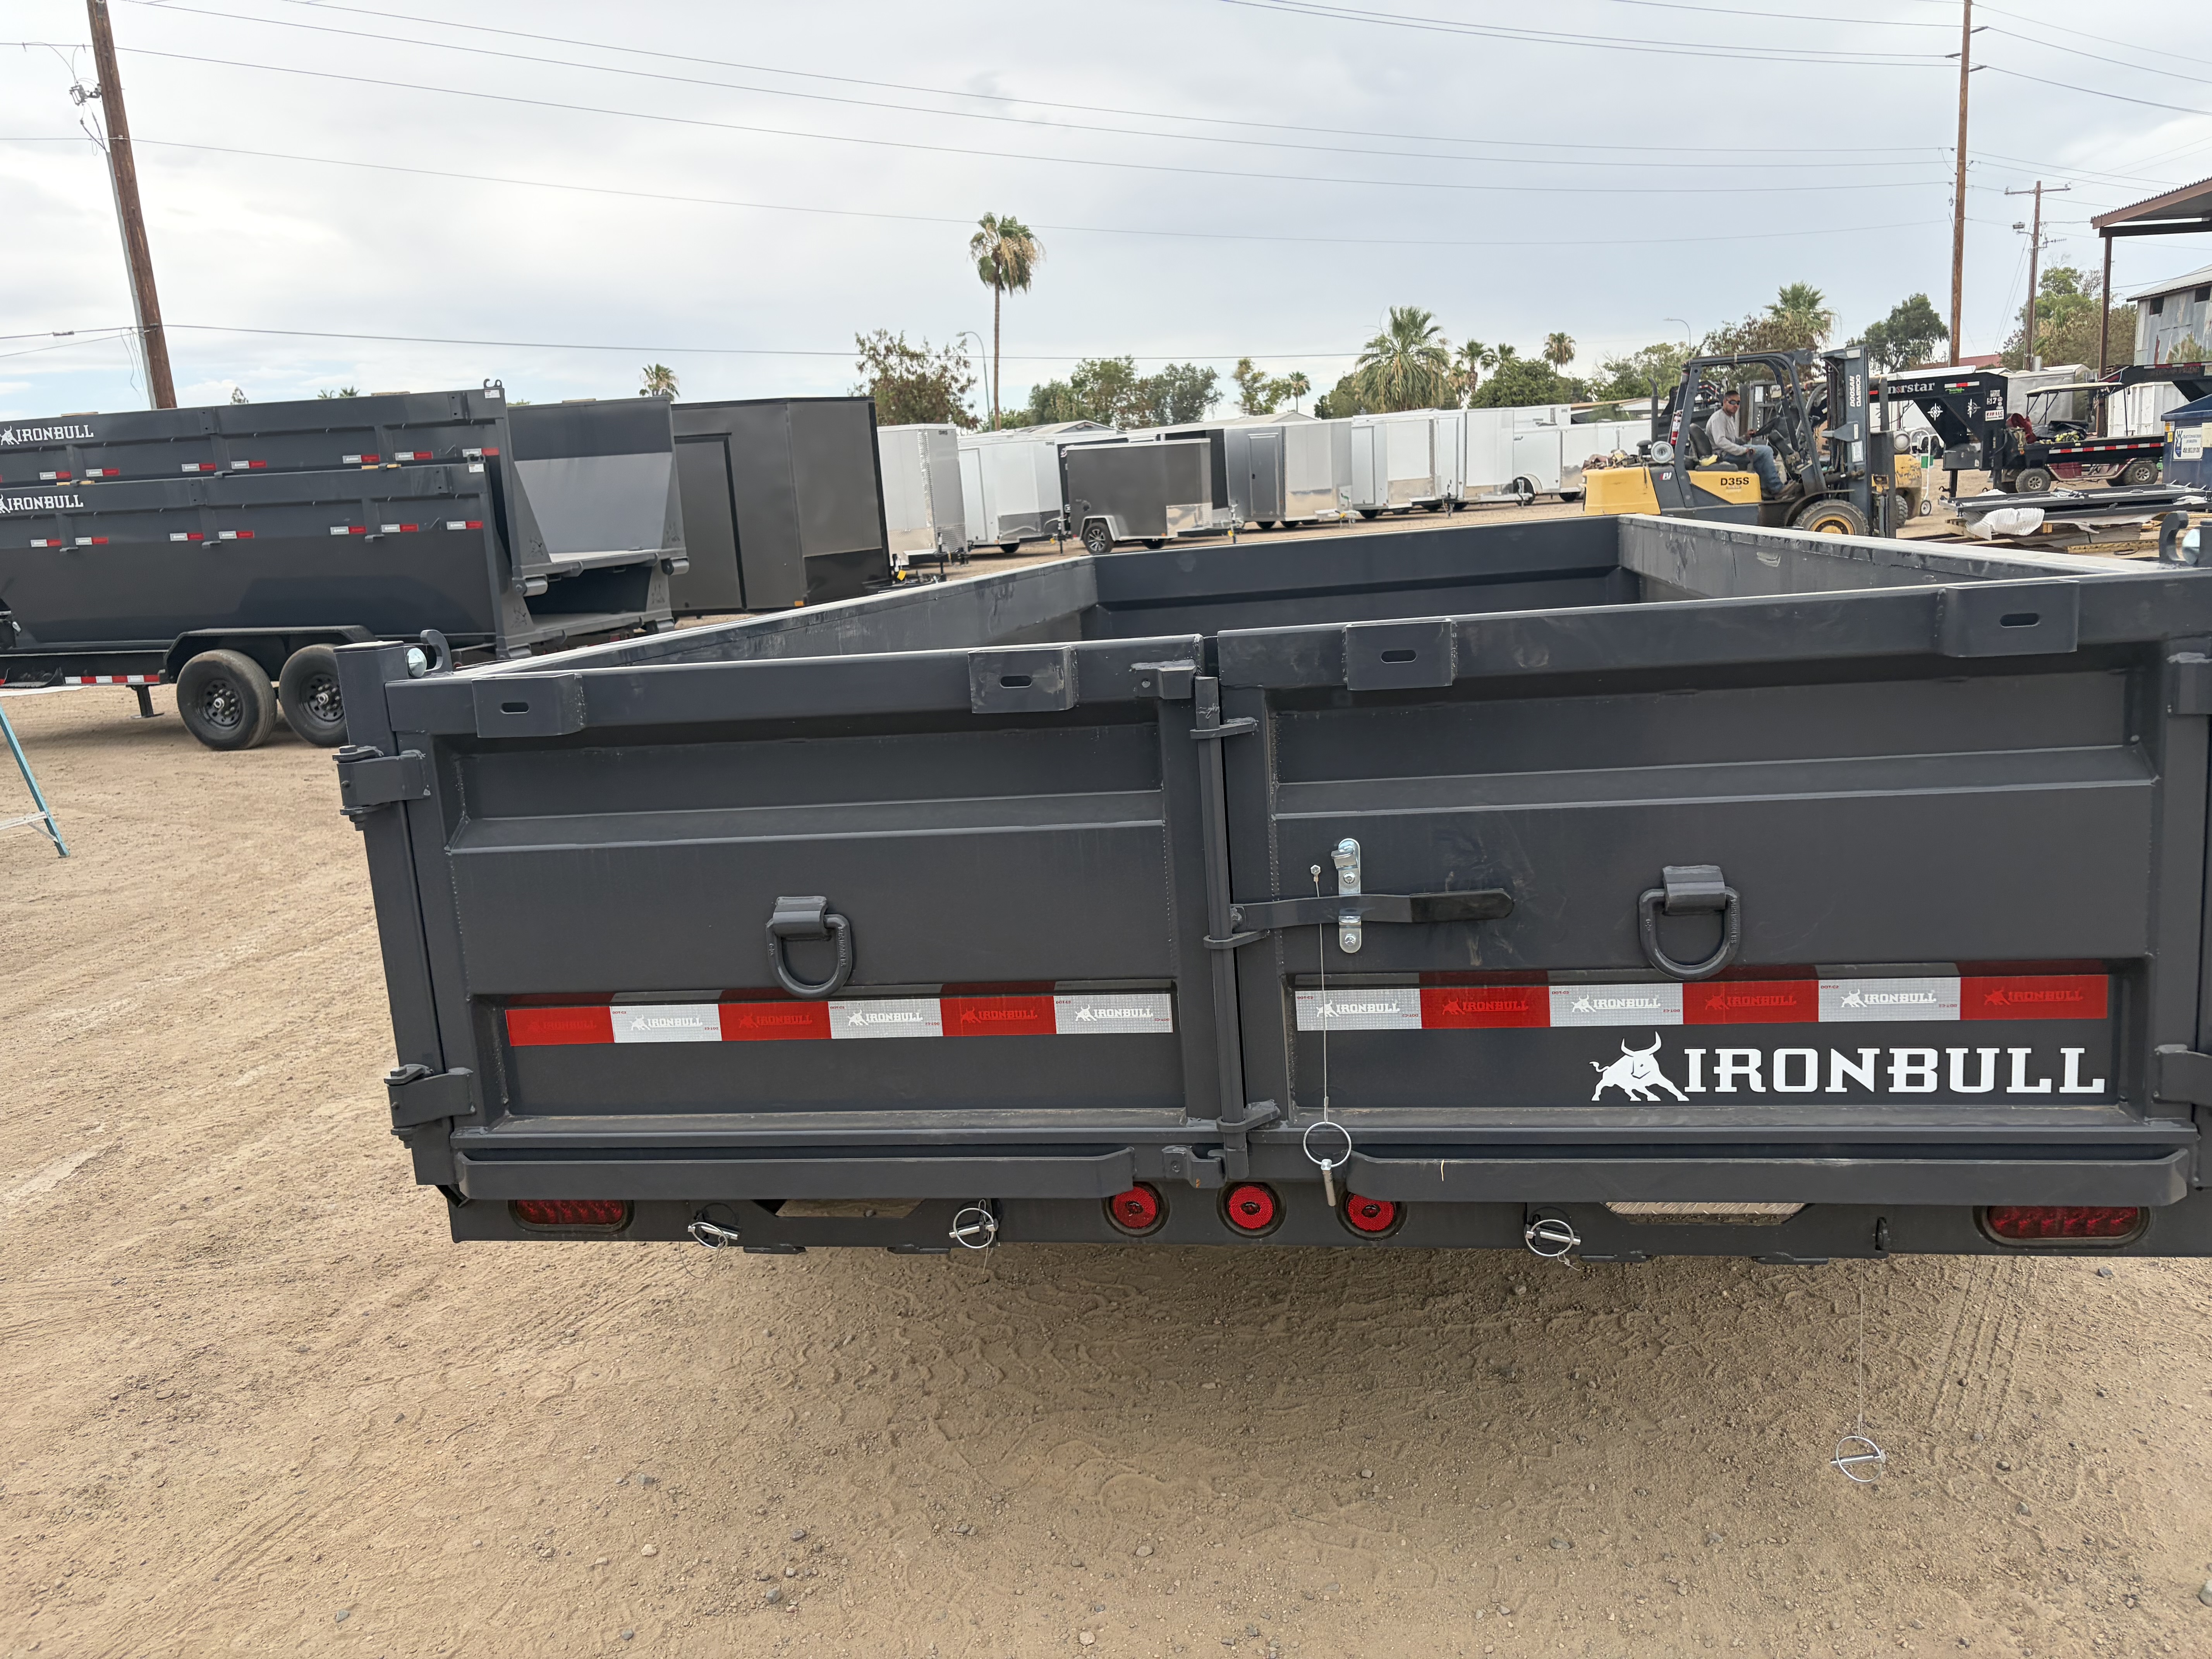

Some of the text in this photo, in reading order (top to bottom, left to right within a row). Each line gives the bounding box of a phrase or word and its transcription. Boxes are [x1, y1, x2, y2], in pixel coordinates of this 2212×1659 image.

[16, 424, 94, 442] IRONBULL
[1721, 477, 1749, 486] D35S
[7, 495, 84, 511] IRONBULL
[1727, 996, 1796, 1006] IRONBULL
[1864, 993, 1936, 1003] IRONBULL
[2008, 991, 2083, 1002] IRONBULL
[1336, 1003, 1400, 1013] IRONBULL
[1463, 1001, 1528, 1011] IRONBULL
[1593, 998, 1661, 1008] IRONBULL
[866, 1012, 923, 1022] IRONBULL
[979, 1010, 1038, 1020] IRONBULL
[1094, 1008, 1154, 1018] IRONBULL
[647, 1017, 703, 1027] IRONBULL
[757, 1015, 812, 1025] IRONBULL
[1684, 1047, 2105, 1094] IRONBULL
